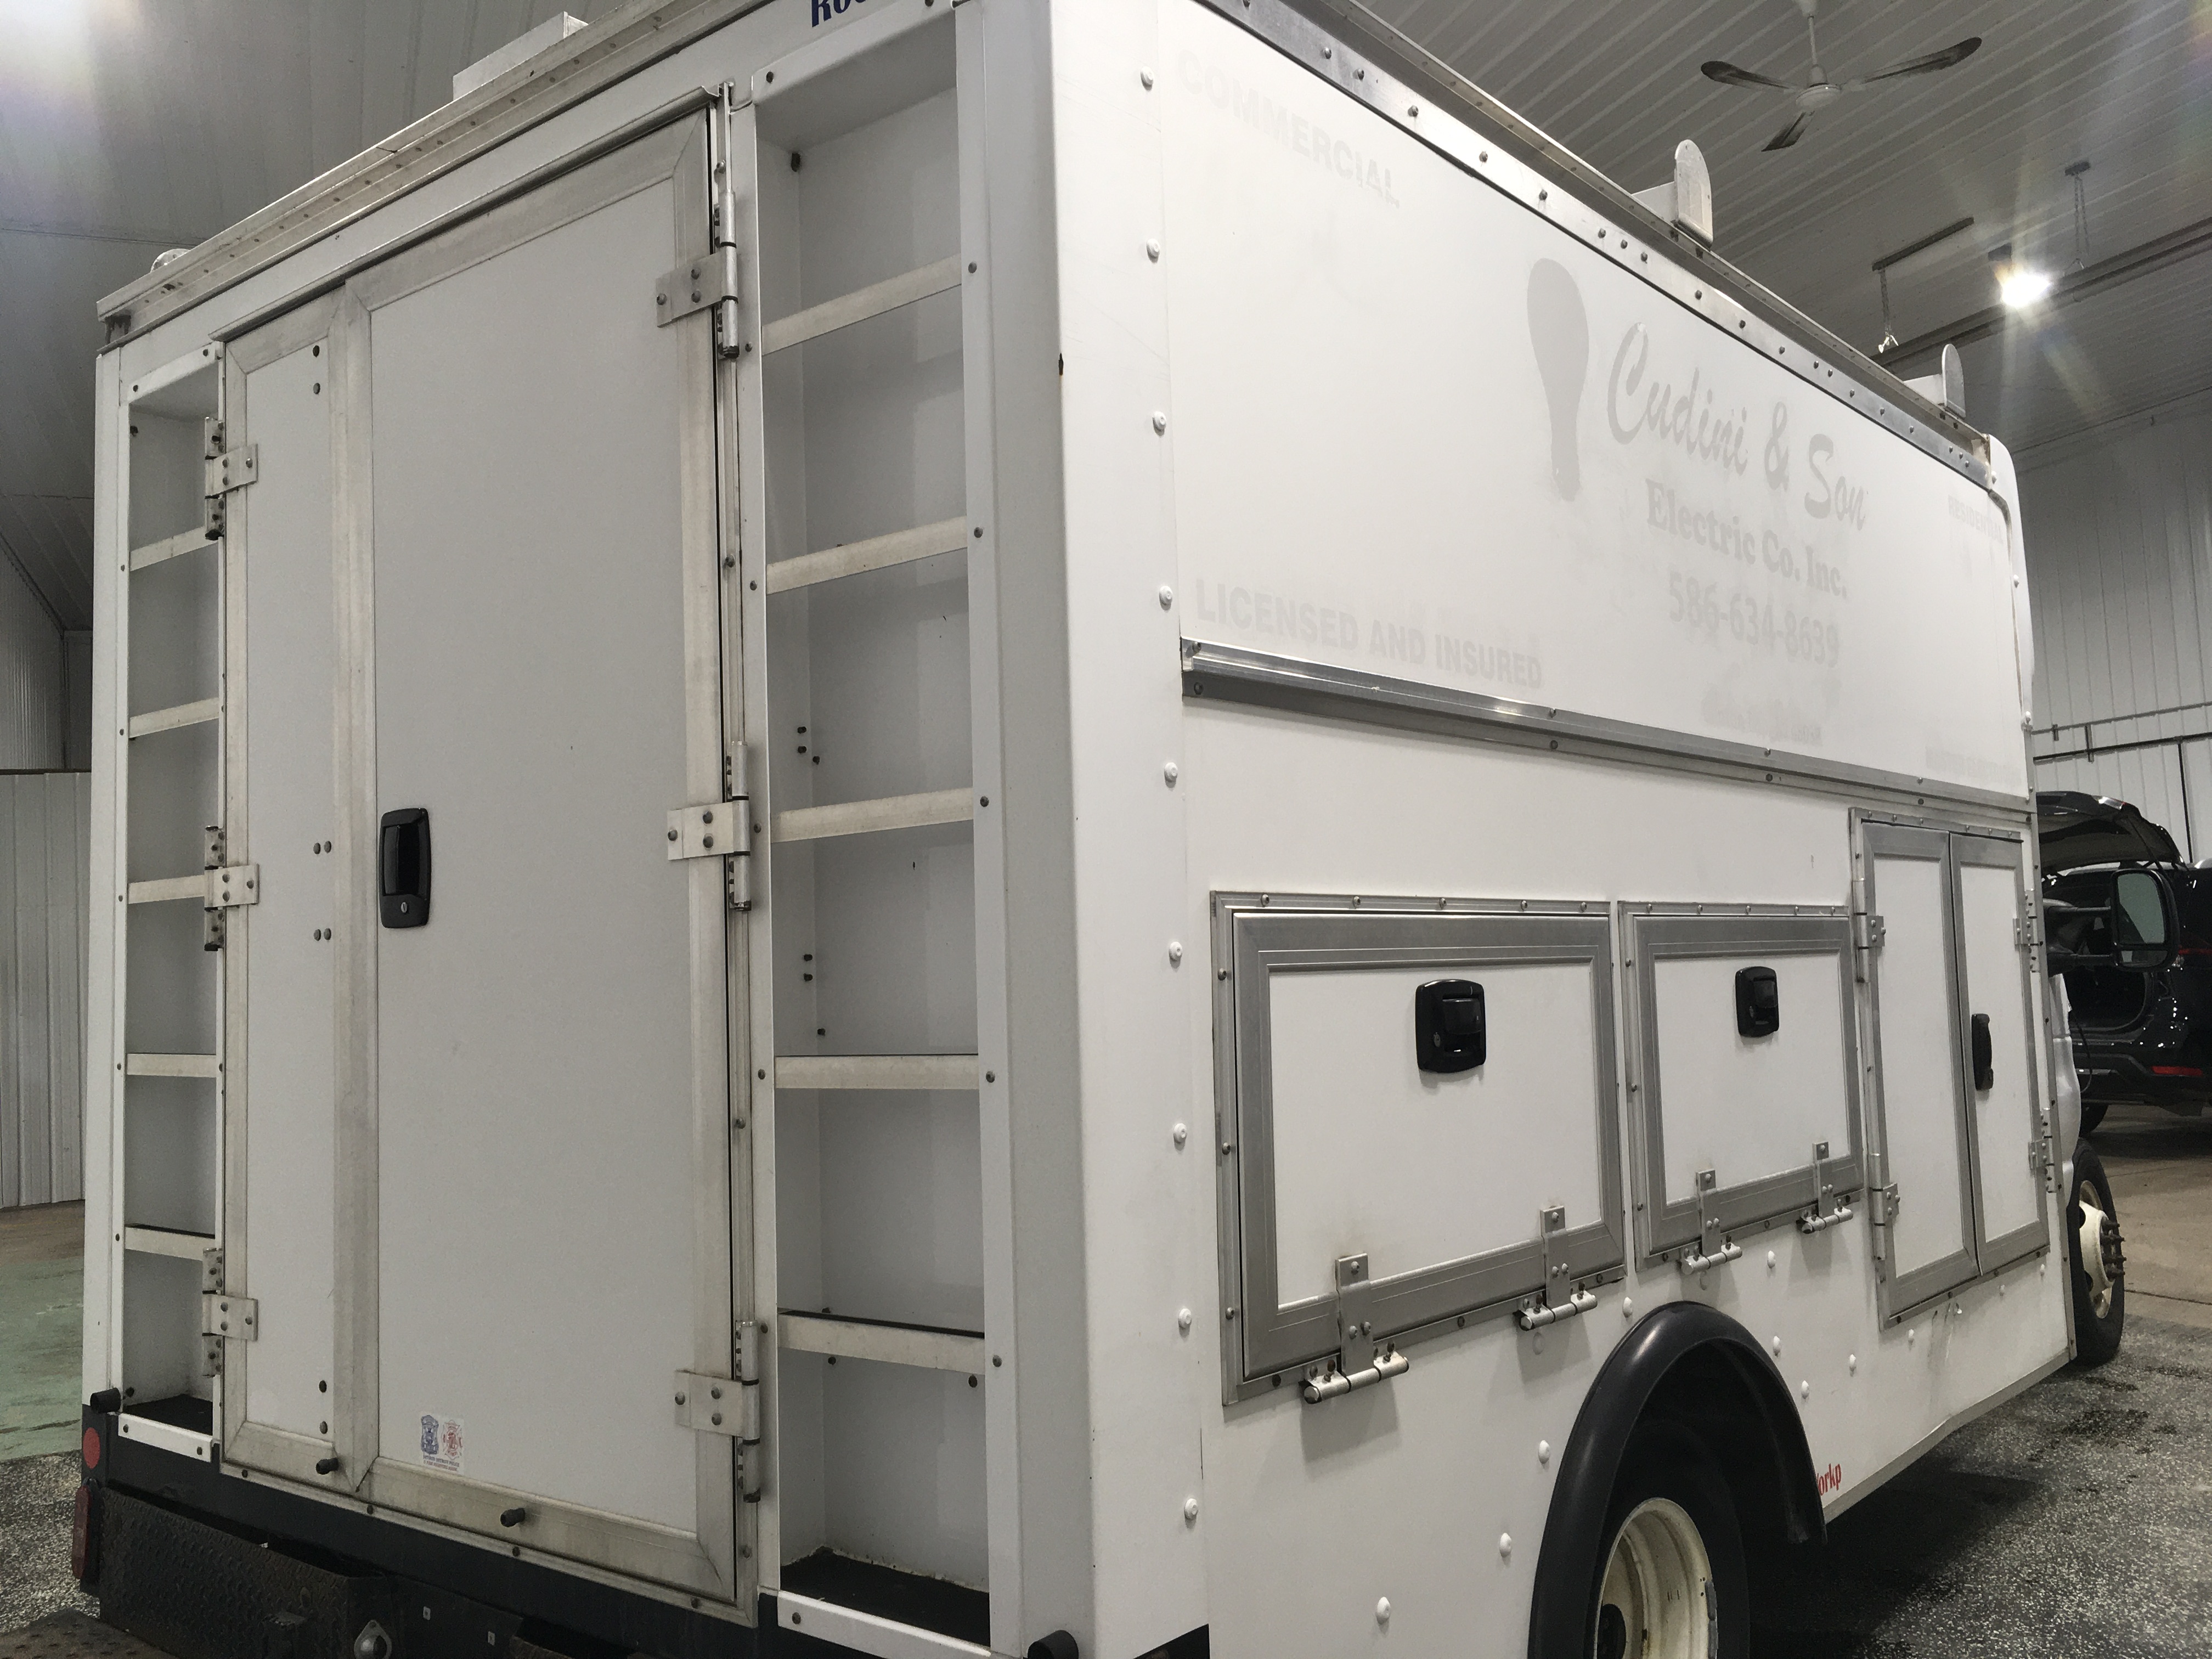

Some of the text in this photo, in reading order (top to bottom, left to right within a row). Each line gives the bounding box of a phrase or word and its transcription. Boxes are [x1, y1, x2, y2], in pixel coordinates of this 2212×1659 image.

[1178, 49, 1400, 209] COMMERCIAL
[1607, 321, 1867, 531] Cudini & Son
[1646, 478, 1756, 565] Electric
[1805, 545, 1847, 600] Inc.
[1195, 578, 1543, 689] LICENSED AND INSURED
[1669, 571, 1839, 668] 586-634-8639
[1816, 1463, 1842, 1496] orkp
